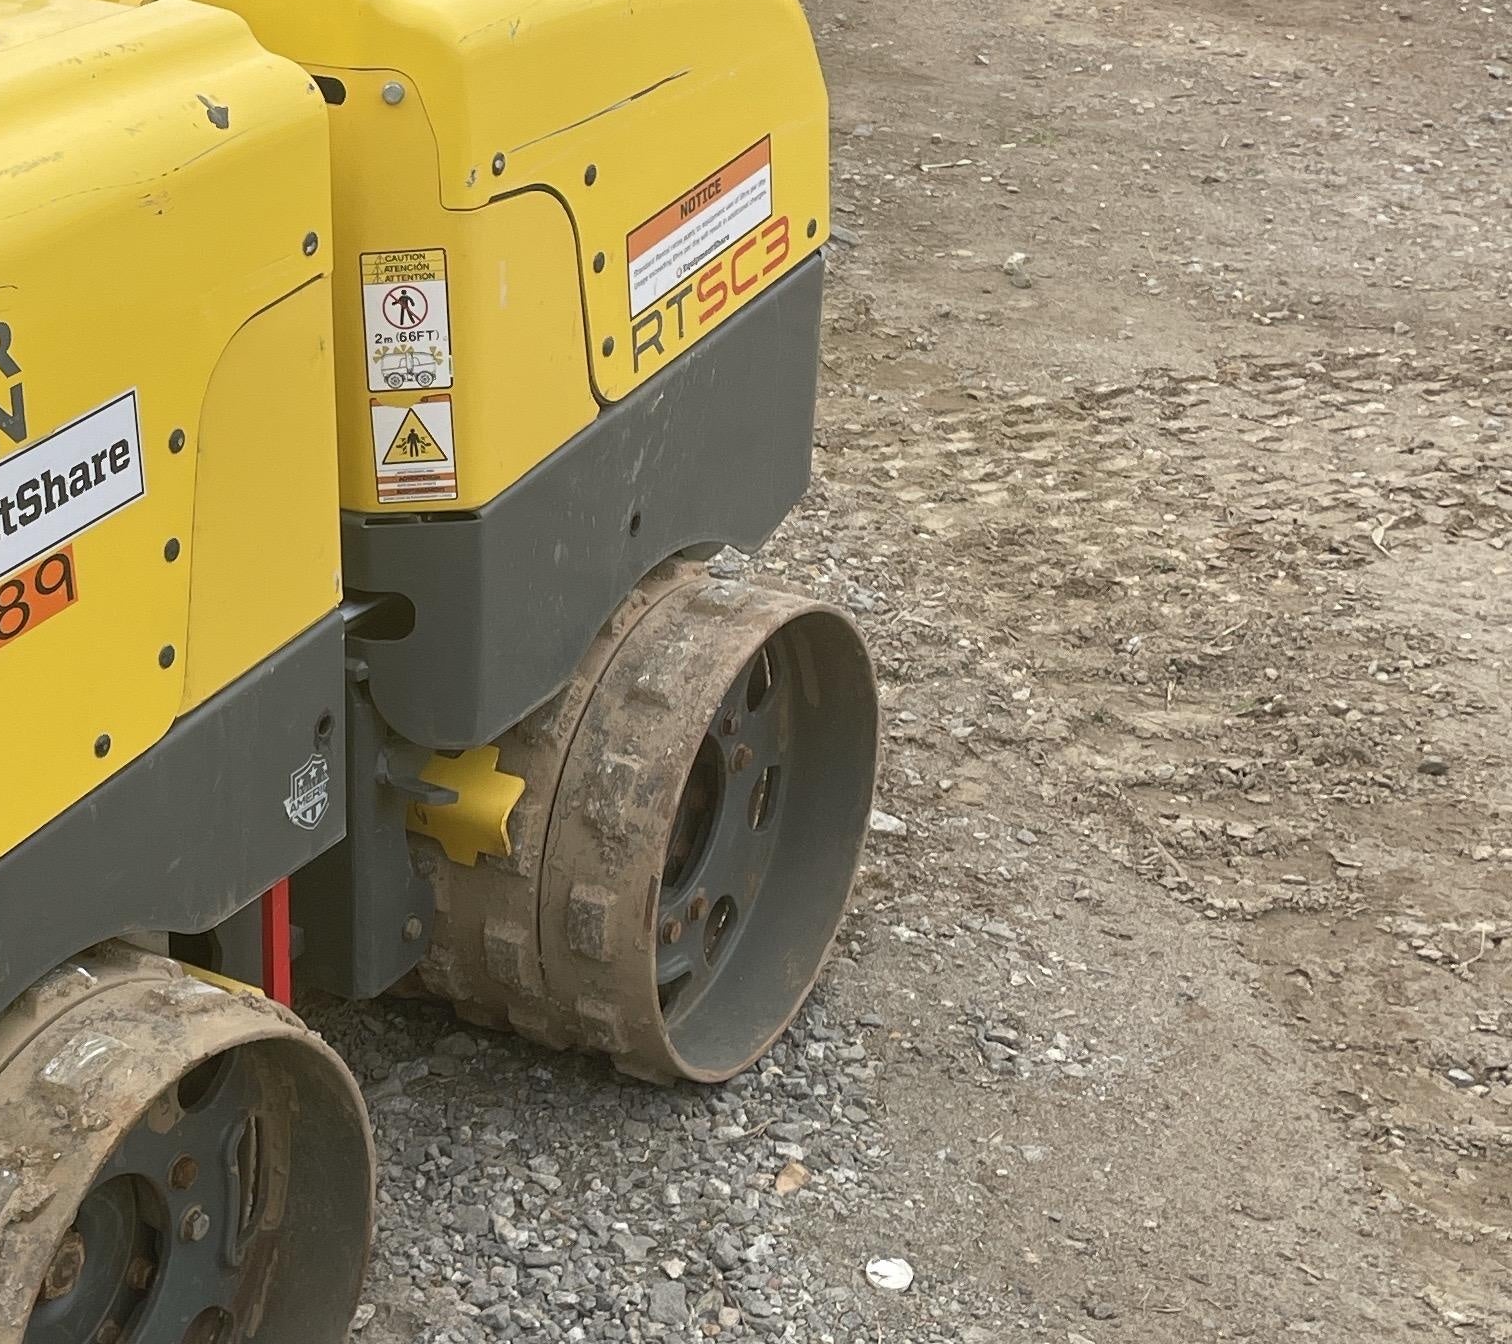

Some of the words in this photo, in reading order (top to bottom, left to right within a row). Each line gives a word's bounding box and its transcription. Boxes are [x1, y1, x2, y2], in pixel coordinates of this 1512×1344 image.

[679, 177, 722, 220] NOTICE
[384, 253, 426, 263] CAUTION
[384, 262, 430, 273] ATENCIÓN
[385, 272, 436, 283] ATTENTION
[632, 216, 790, 373] RTSC3
